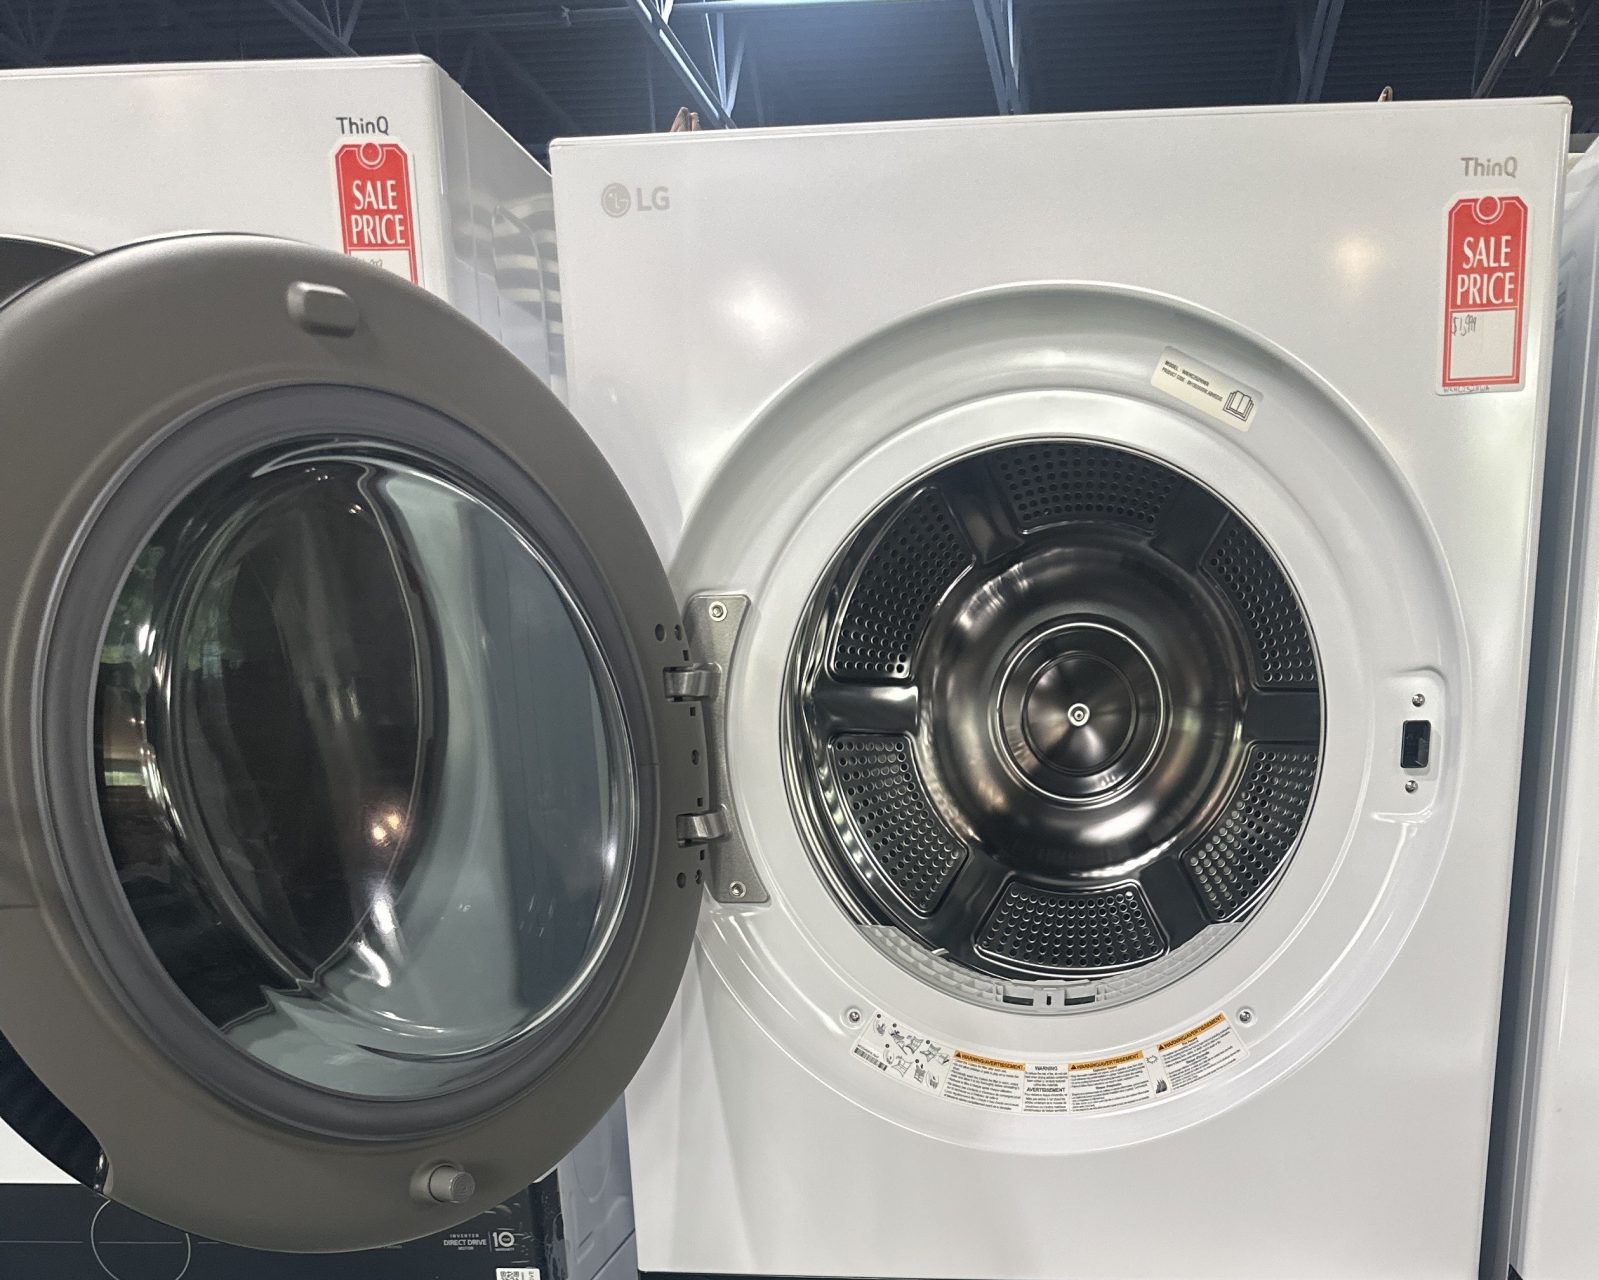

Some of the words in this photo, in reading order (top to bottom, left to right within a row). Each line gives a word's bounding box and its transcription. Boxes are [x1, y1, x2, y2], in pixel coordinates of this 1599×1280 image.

[336, 116, 389, 135] ThinQ
[1461, 156, 1518, 178] ThinQ
[352, 180, 397, 210] SALE
[636, 186, 670, 211] LG
[351, 214, 405, 245] PRICE
[1462, 235, 1512, 270] SALE
[1456, 272, 1515, 305] PRICE
[492, 1231, 515, 1248] 10
